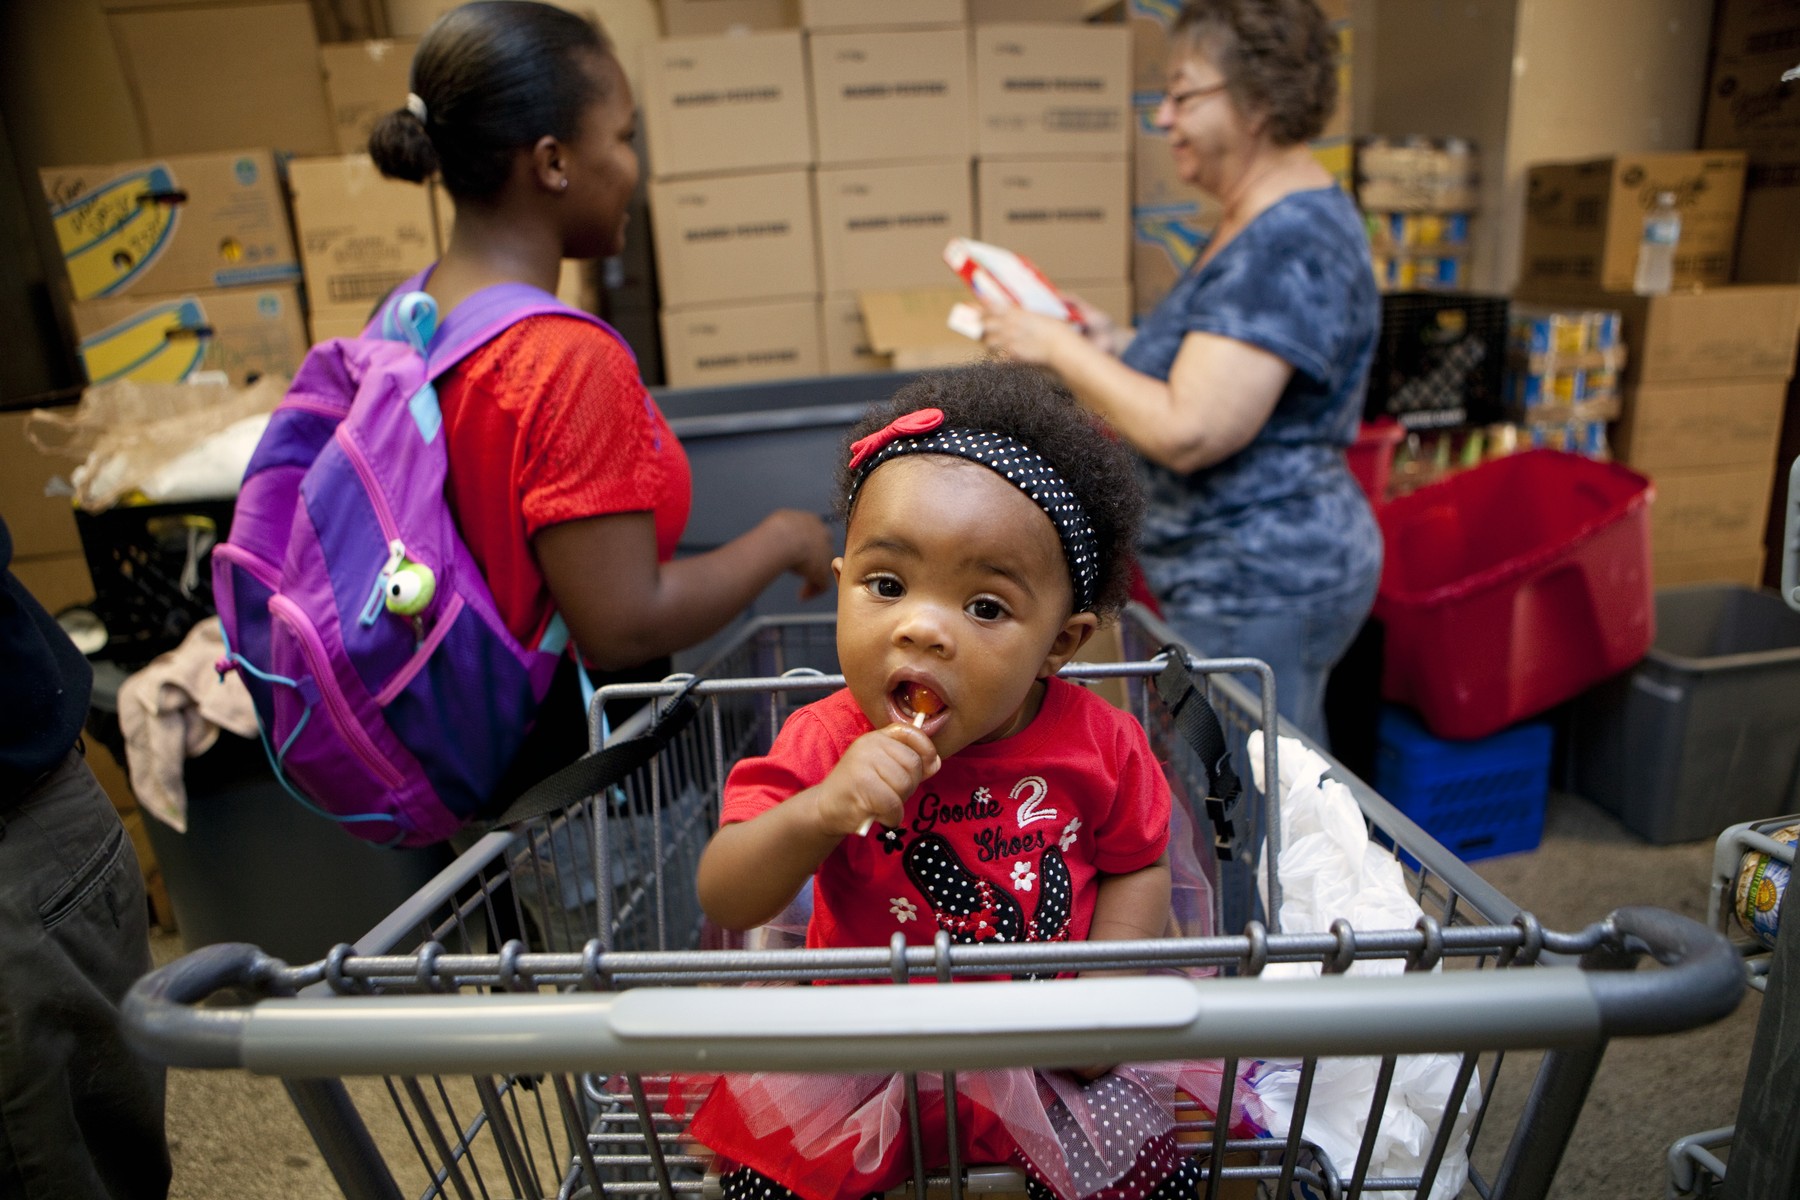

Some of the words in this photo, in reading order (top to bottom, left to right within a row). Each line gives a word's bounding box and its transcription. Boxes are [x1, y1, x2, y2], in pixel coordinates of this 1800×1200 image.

[912, 788, 1003, 833] Goodie
[1008, 776, 1057, 829] 2
[974, 826, 1046, 862] Shoes
